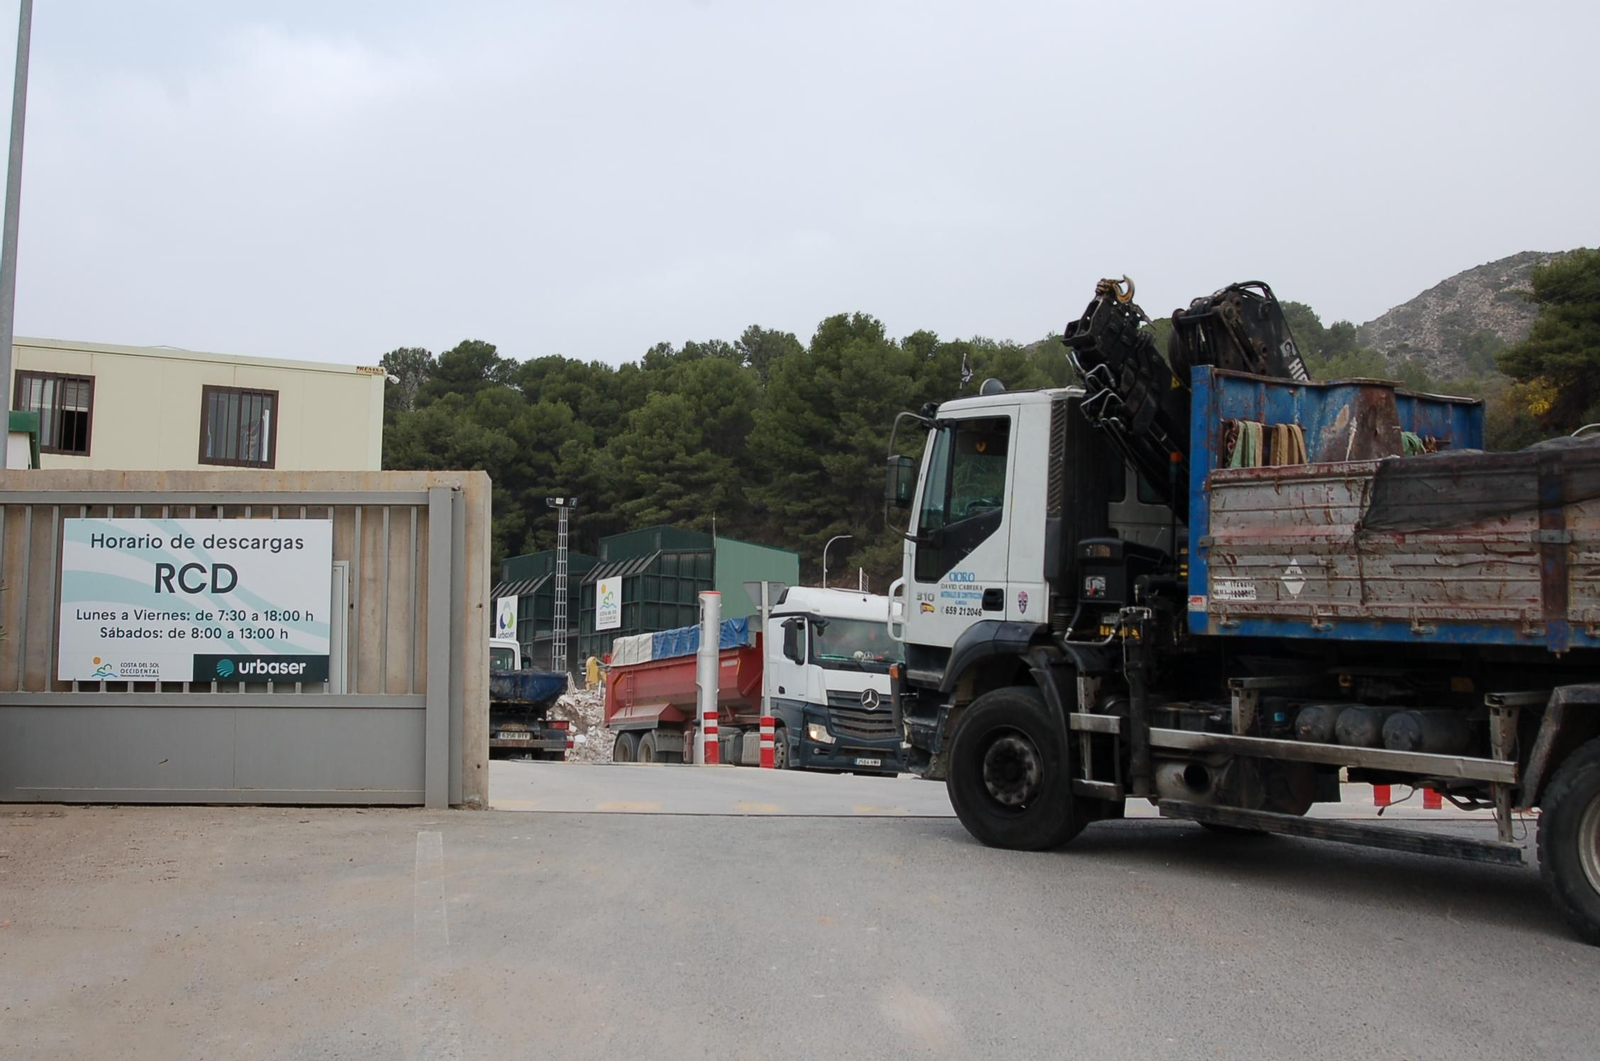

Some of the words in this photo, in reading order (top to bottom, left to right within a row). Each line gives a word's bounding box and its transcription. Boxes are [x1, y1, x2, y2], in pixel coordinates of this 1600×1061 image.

[90, 533, 163, 549] Horario
[170, 533, 195, 549] de
[203, 534, 304, 553] descargas
[154, 562, 238, 594] RCD
[76, 609, 116, 621] Lunes
[121, 612, 129, 621] a
[133, 609, 191, 622] Viernes:
[195, 609, 213, 622] de
[218, 610, 247, 622] 7:30
[251, 613, 259, 622] a
[264, 610, 300, 622] 18:00
[305, 610, 314, 622] h
[945, 606, 957, 615] 659
[959, 607, 982, 616] 212046
[100, 626, 163, 639] Sábados:
[168, 627, 186, 639] de
[191, 627, 222, 639] 8:00
[227, 630, 235, 639] a
[239, 627, 275, 639] 13:00
[280, 627, 289, 639] h
[238, 658, 307, 676] urbaser
